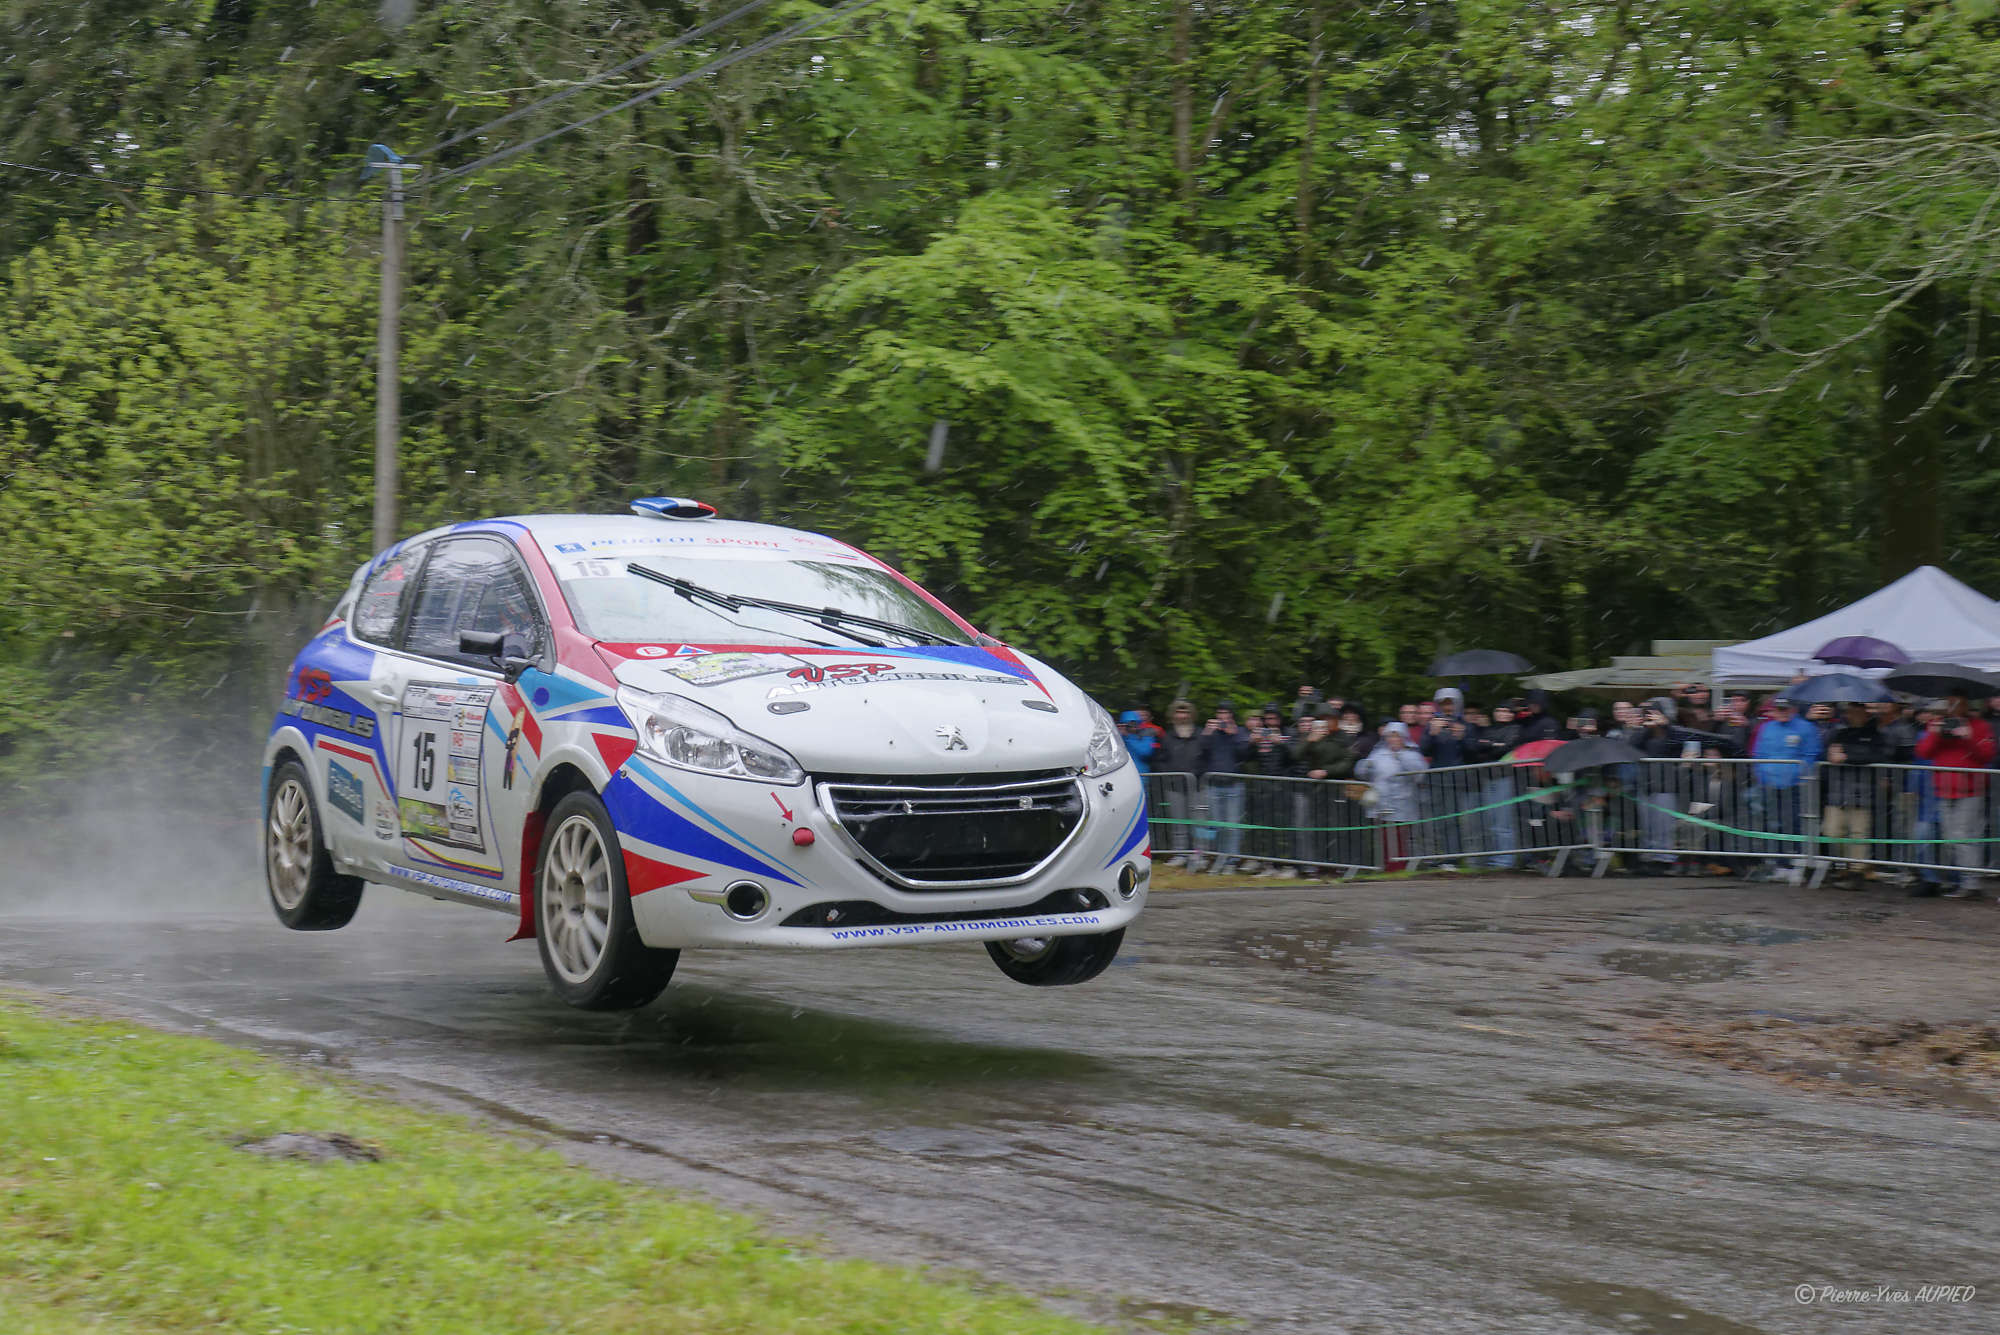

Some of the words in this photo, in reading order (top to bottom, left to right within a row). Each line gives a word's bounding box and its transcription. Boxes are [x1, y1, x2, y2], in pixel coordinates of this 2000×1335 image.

[591, 537, 695, 546] PEUGEOT
[706, 537, 782, 548] SPORT
[571, 560, 611, 577] 15
[787, 663, 896, 682] VSP
[767, 672, 1028, 699] AUTOMOBILES
[414, 731, 436, 792] 15
[831, 915, 1100, 940] WWW.VSP-AUTOMOBILES.COM
